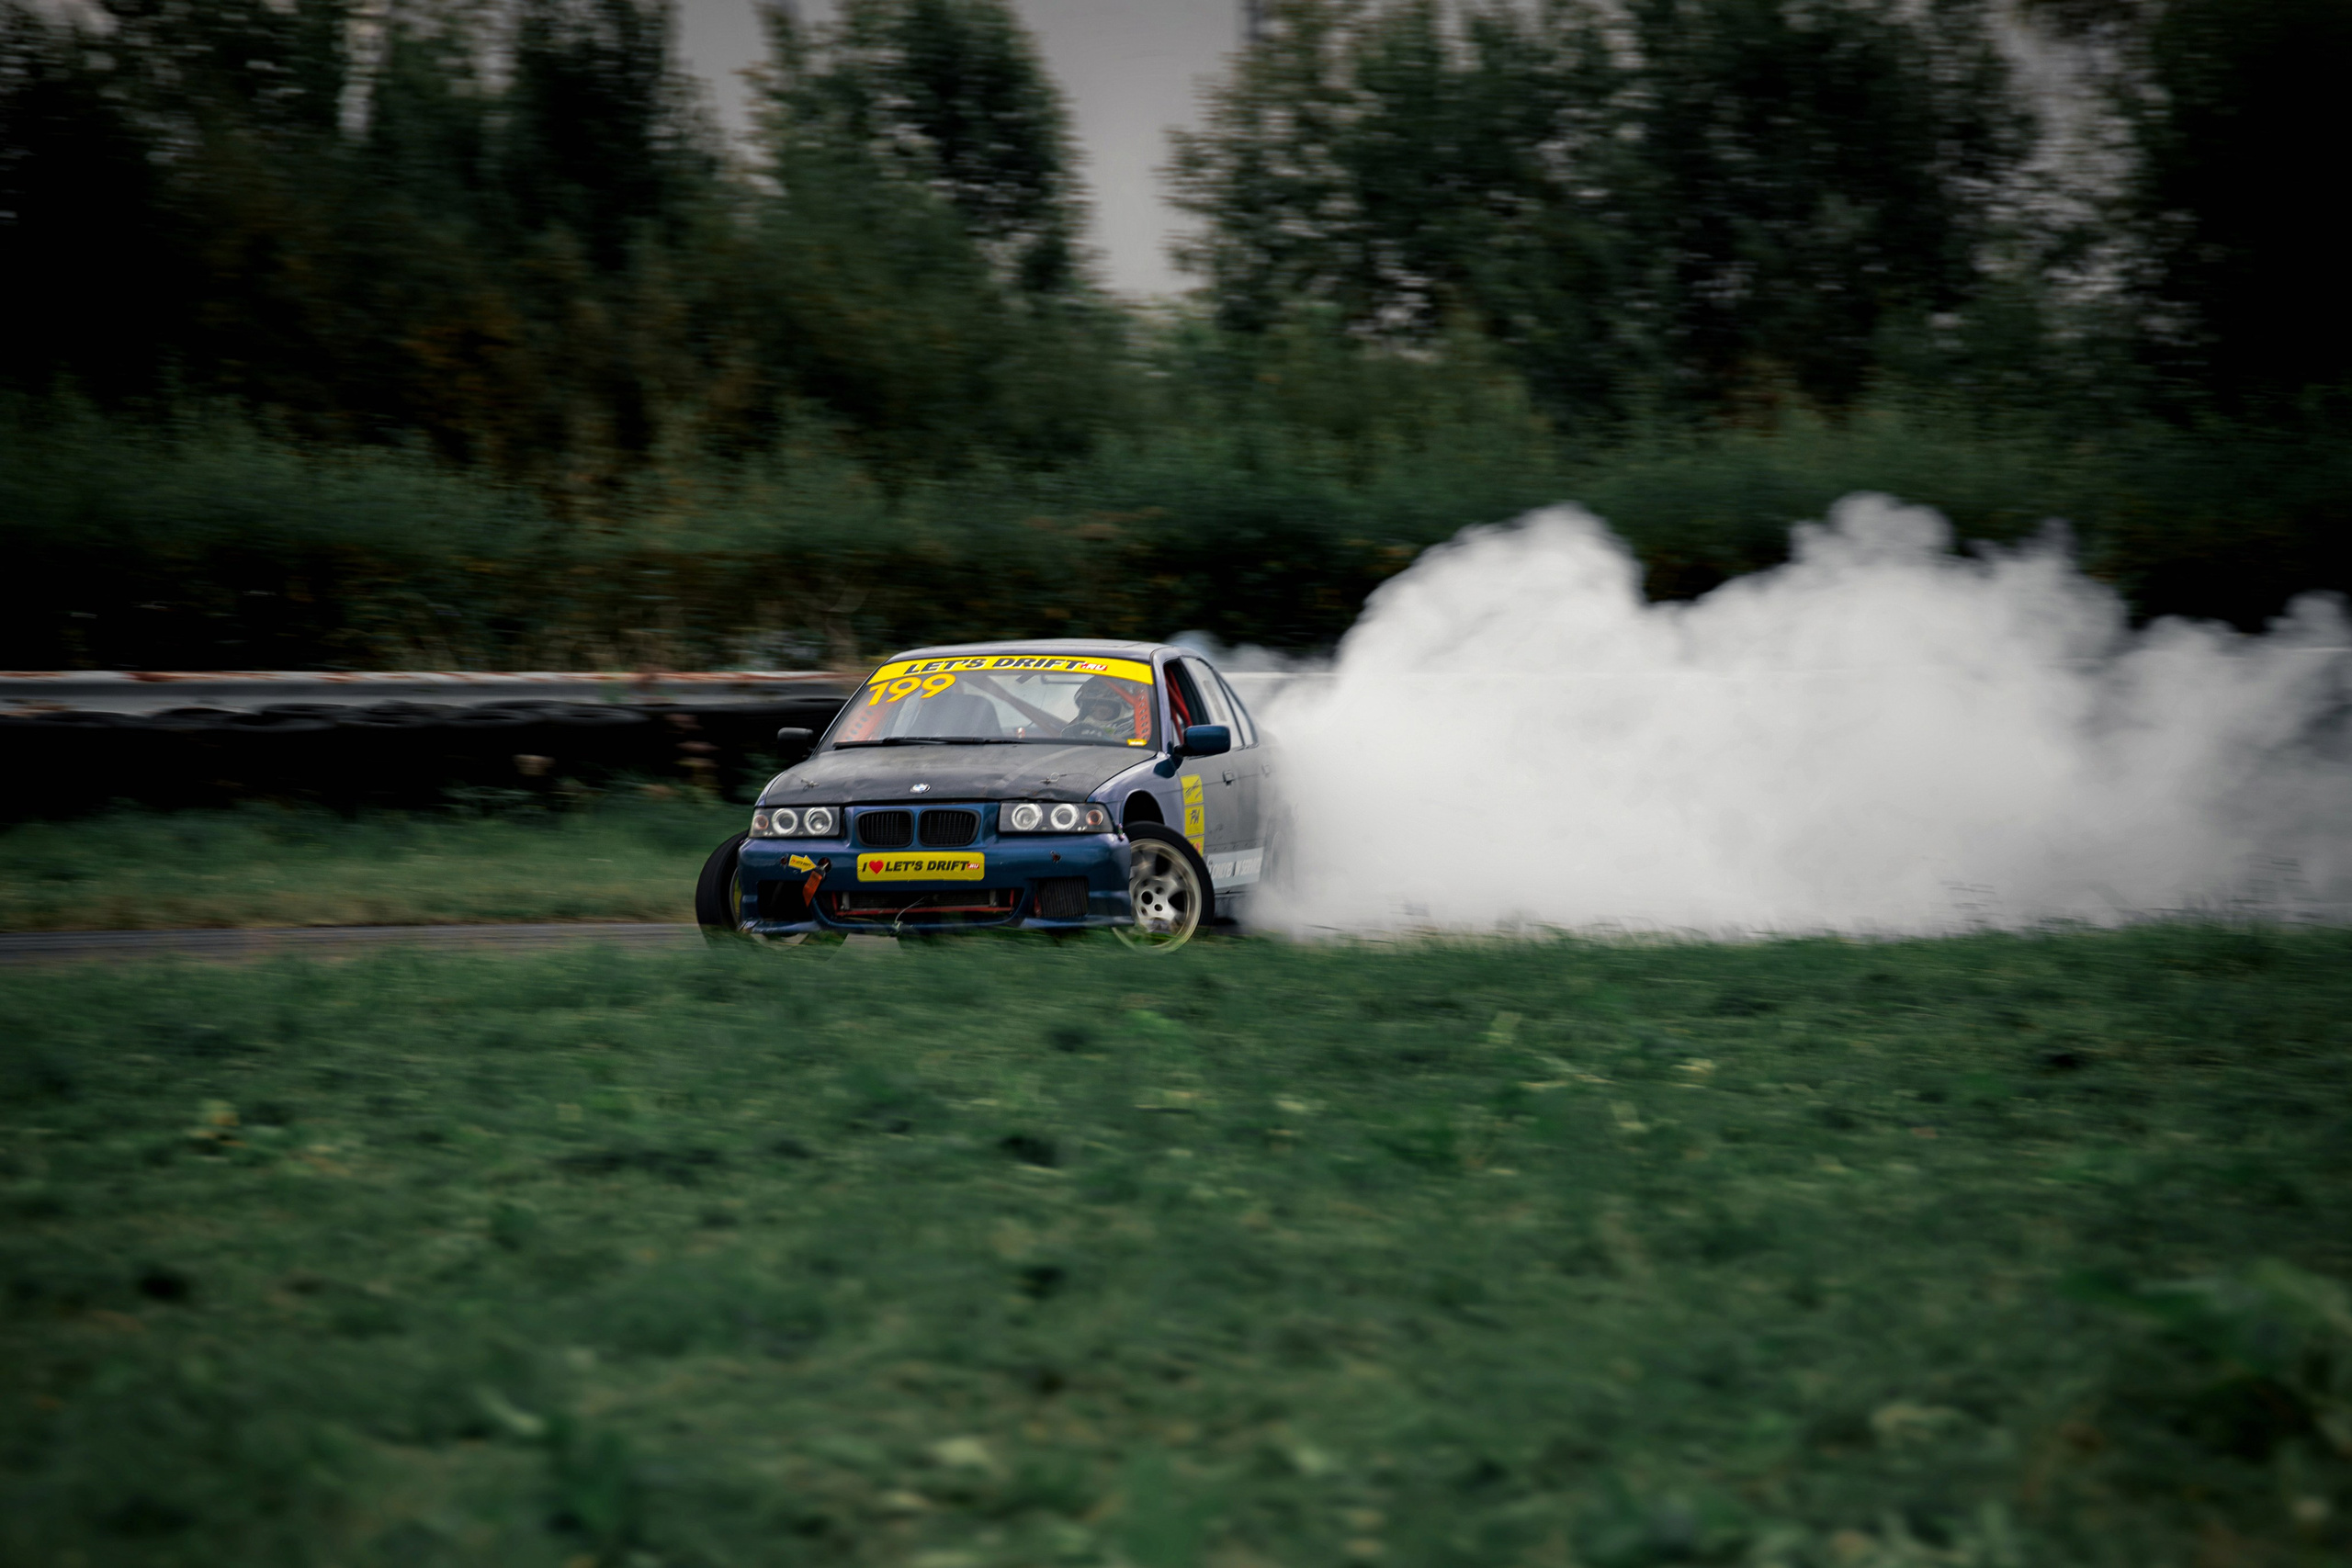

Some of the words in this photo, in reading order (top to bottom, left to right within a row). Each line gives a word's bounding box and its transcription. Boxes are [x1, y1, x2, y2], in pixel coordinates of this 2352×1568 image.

[904, 659, 988, 675] LET'S
[867, 673, 956, 706] 199
[862, 862, 867, 873] I
[885, 860, 924, 872] LET'S
